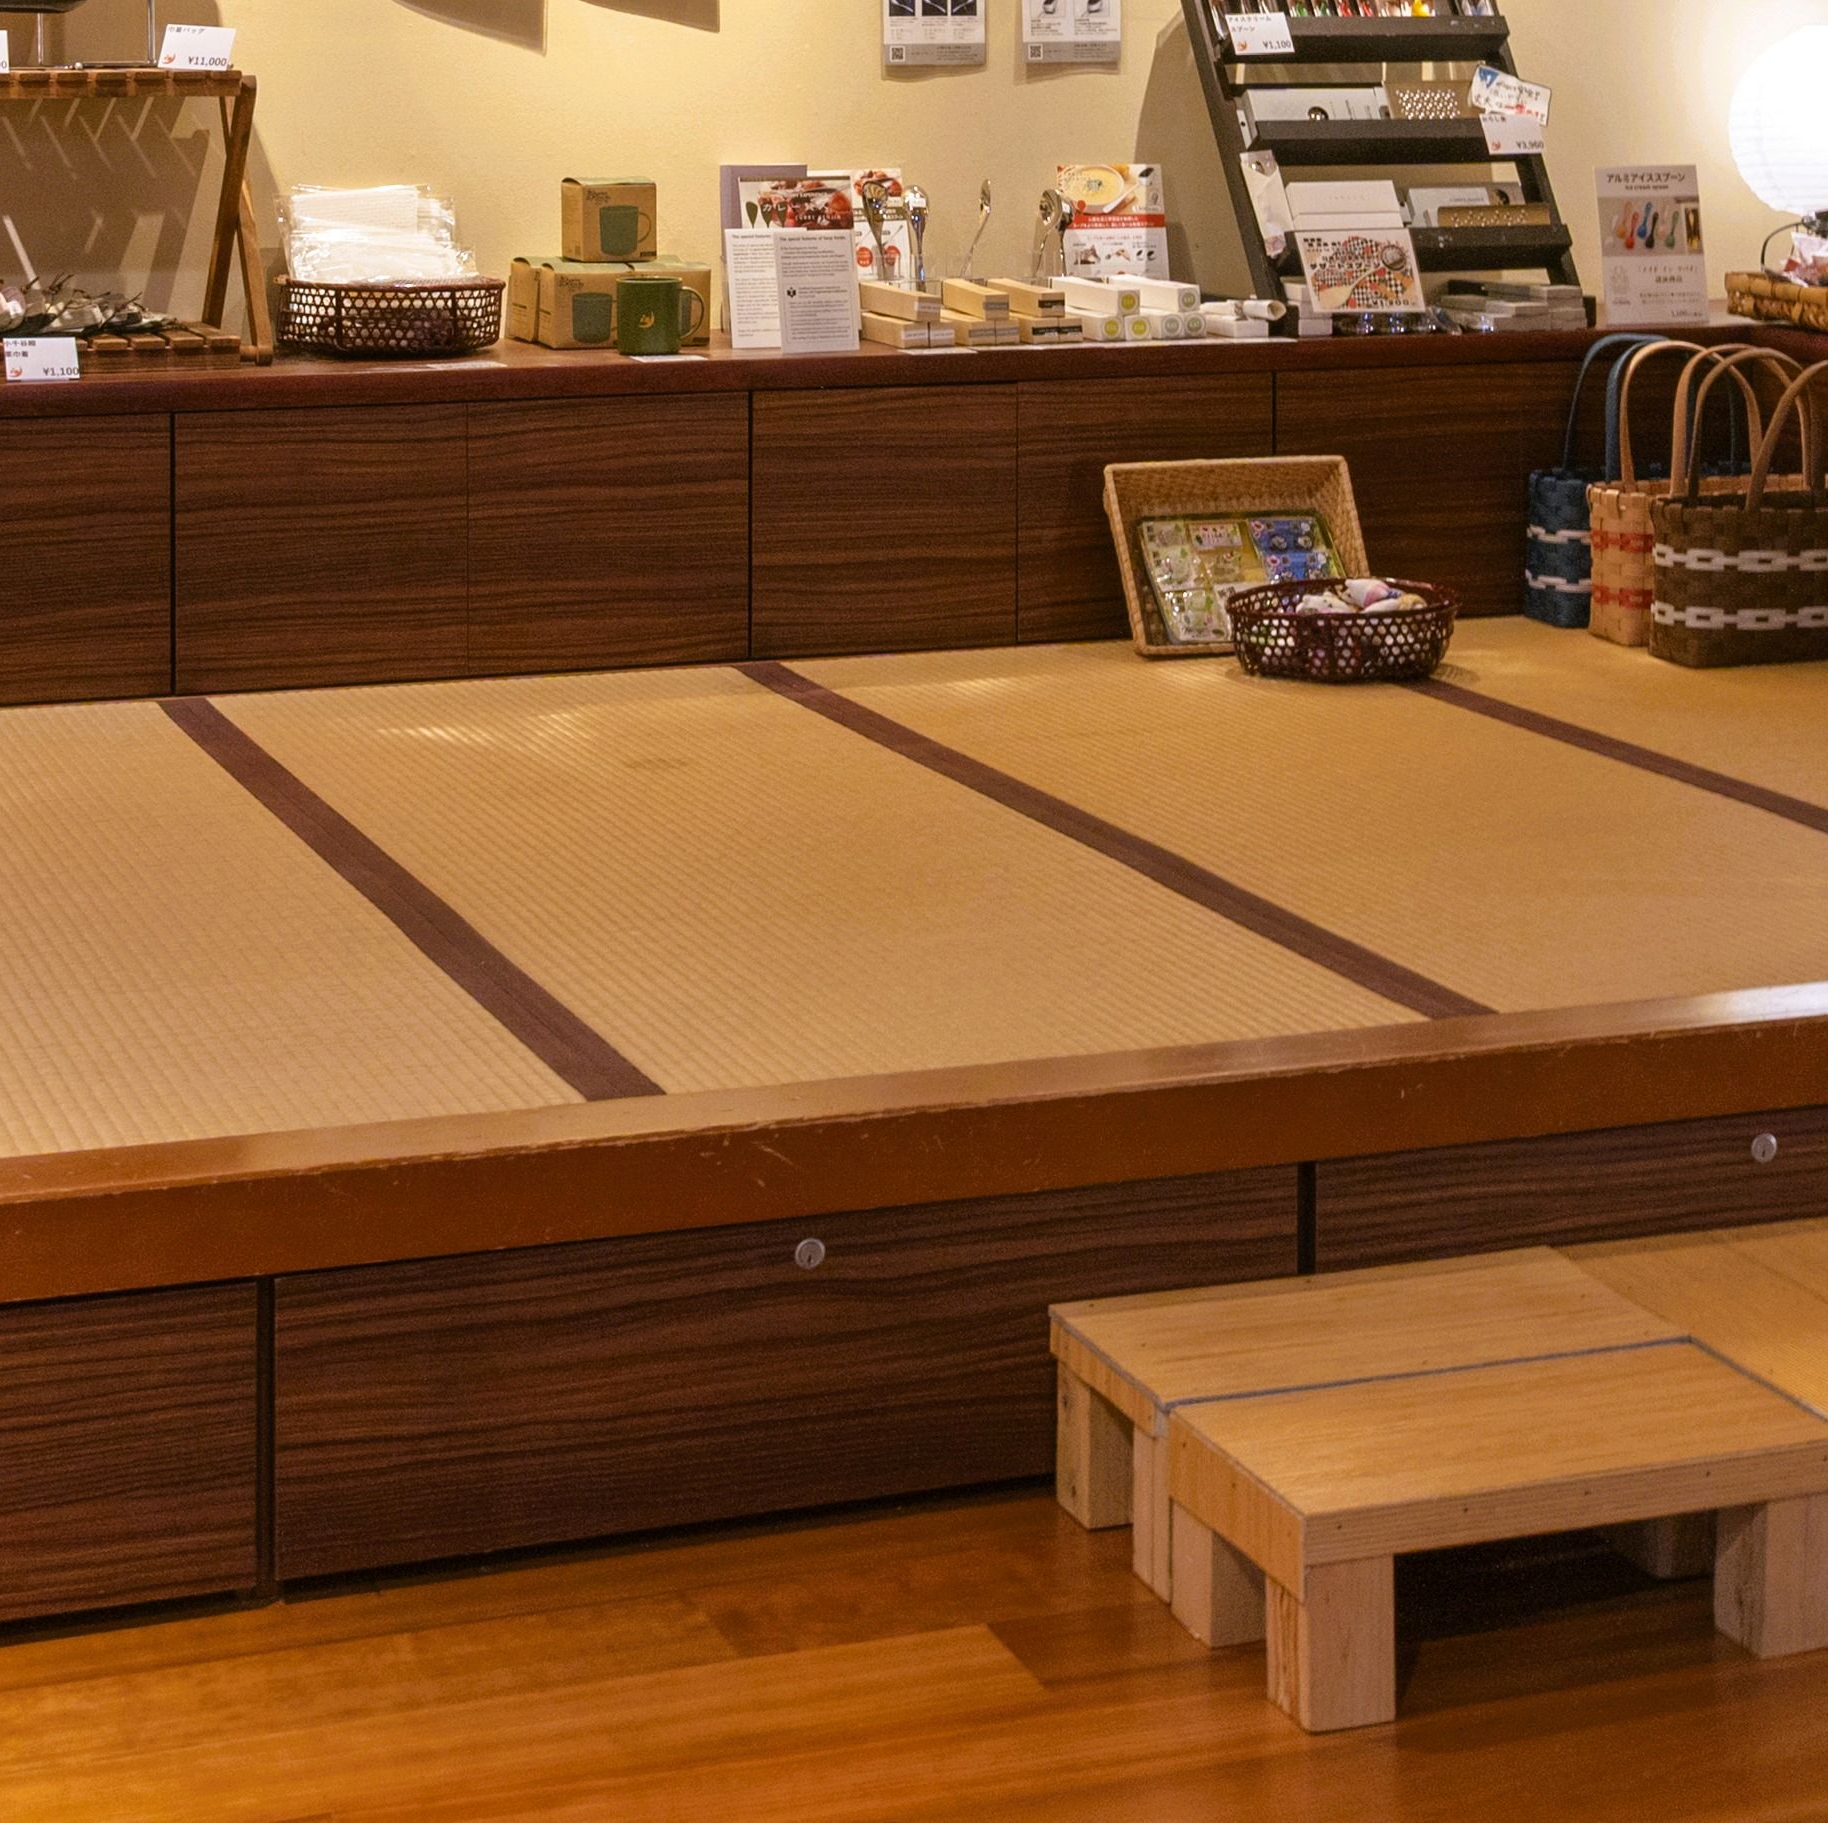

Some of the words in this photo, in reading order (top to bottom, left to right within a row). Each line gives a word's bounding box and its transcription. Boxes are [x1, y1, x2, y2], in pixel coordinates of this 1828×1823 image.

[1262, 40, 1291, 49] ¥1,100
[188, 56, 228, 66] ¥11,000
[1606, 173, 1686, 183] アルミアイススプーン
[43, 367, 79, 376] ¥1,100
